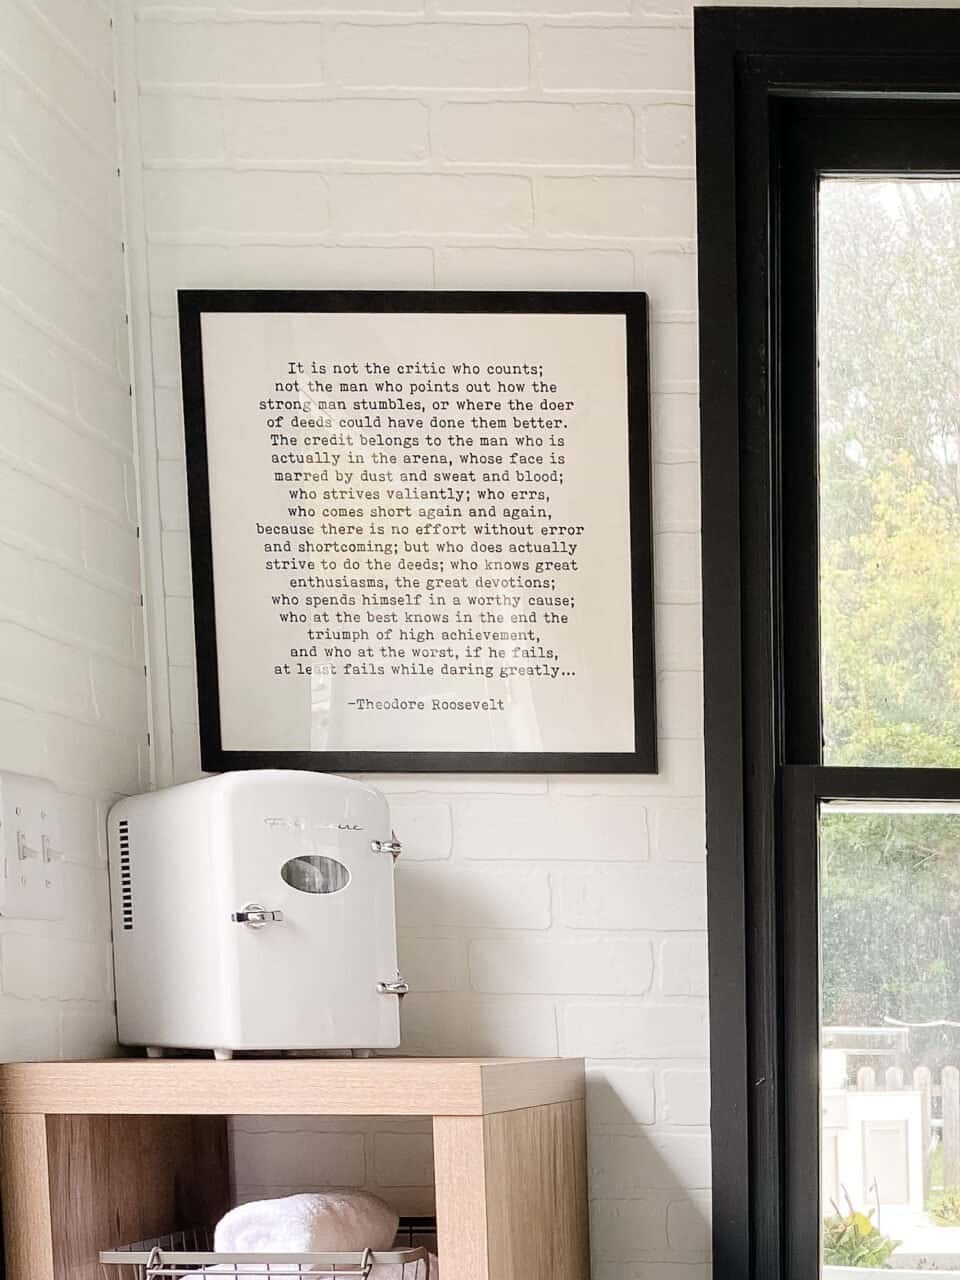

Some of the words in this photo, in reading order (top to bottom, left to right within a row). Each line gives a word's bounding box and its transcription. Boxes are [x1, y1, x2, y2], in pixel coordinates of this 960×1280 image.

[287, 361, 305, 375] It
[311, 361, 327, 375] is
[332, 362, 359, 375] not
[364, 361, 391, 375] the
[396, 361, 446, 375] critic
[451, 362, 481, 375] who
[486, 363, 543, 378] counts;
[274, 380, 301, 393] not
[308, 380, 333, 393] the
[339, 382, 369, 393] man
[374, 380, 403, 393] who
[409, 379, 460, 396] points
[465, 380, 492, 393] out
[497, 380, 526, 393] how
[530, 380, 558, 394] the
[258, 397, 312, 414] strong
[317, 400, 347, 410] man
[352, 397, 426, 413] stumbles,
[431, 400, 450, 411] or
[455, 398, 502, 411] where
[506, 398, 534, 412] the
[539, 398, 575, 411] doer
[266, 415, 285, 429] of
[290, 415, 333, 429] deeds
[338, 415, 382, 429] could
[387, 416, 424, 429] have
[429, 415, 465, 429] done
[470, 416, 507, 429] them
[512, 416, 568, 430] better.
[269, 433, 298, 447] The
[303, 433, 354, 447] credit
[359, 433, 420, 449] belongs
[425, 434, 442, 447] to
[447, 434, 474, 447] the
[479, 436, 509, 447] man
[514, 434, 544, 447] who
[549, 434, 565, 447] is
[271, 451, 341, 467] actually
[347, 450, 365, 464] in
[371, 451, 398, 465] the
[403, 454, 453, 467] arena,
[459, 452, 503, 465] whose
[509, 452, 544, 465] face
[549, 451, 566, 465] is
[274, 469, 329, 483] marred
[334, 470, 354, 485] by
[360, 469, 394, 483] dust
[399, 469, 428, 482] and
[433, 470, 477, 483] sweat
[482, 469, 510, 483] and
[515, 469, 564, 485] blood;
[288, 487, 317, 500] who
[322, 487, 380, 501] strives
[386, 487, 471, 503] valiantly;
[476, 487, 505, 500] who
[510, 490, 550, 503] errs,
[287, 505, 316, 518] who
[321, 507, 364, 518] comes
[369, 505, 413, 518] short
[418, 504, 462, 520] again
[468, 505, 497, 518] and
[502, 505, 552, 521] again,
[255, 522, 315, 535] because
[320, 522, 364, 536] there
[369, 522, 385, 535] is
[391, 525, 409, 536] no
[415, 522, 467, 536] effort
[473, 522, 535, 536] without
[540, 525, 585, 536] error
[264, 540, 292, 553] and
[297, 540, 399, 556] shortcoming;
[403, 540, 430, 553] but
[435, 541, 464, 553] who
[470, 540, 503, 554] does
[508, 540, 578, 557] actually
[265, 557, 316, 571] strive
[320, 560, 337, 571] to
[343, 557, 361, 571] do
[365, 558, 392, 571] the
[397, 557, 444, 573] deeds;
[449, 558, 479, 571] who
[484, 559, 530, 571] knows
[534, 559, 578, 574] great
[289, 575, 389, 591] enthusiasms,
[394, 576, 421, 589] the
[425, 578, 469, 591] great
[474, 575, 556, 592] devotions;
[271, 593, 300, 606] who
[305, 593, 356, 609] spends
[361, 593, 423, 606] himself
[428, 593, 447, 606] in
[452, 596, 462, 606] a
[467, 594, 521, 609] worthy
[528, 596, 575, 609] cause;
[279, 611, 307, 624] who
[313, 611, 330, 623] at
[335, 610, 361, 624] the
[366, 610, 399, 623] best
[404, 611, 449, 624] knows
[455, 610, 473, 624] in
[479, 611, 505, 624] the
[510, 610, 537, 624] end
[543, 611, 569, 624] the
[307, 628, 369, 643] triumph
[375, 628, 393, 641] of
[399, 627, 435, 644] high
[441, 627, 541, 644] achievement,
[290, 645, 318, 658] and
[323, 646, 352, 658] who
[357, 646, 375, 658] at
[378, 645, 406, 659] the
[411, 646, 459, 662] worst,
[465, 645, 483, 658] if
[487, 646, 506, 659] he
[511, 645, 559, 662] fails,
[273, 663, 291, 675] at
[296, 662, 337, 676] least
[343, 662, 385, 676] fails
[390, 662, 435, 676] while
[440, 662, 494, 679] daring
[499, 663, 576, 679] greatly...
[431, 698, 505, 711] Roosevelt
